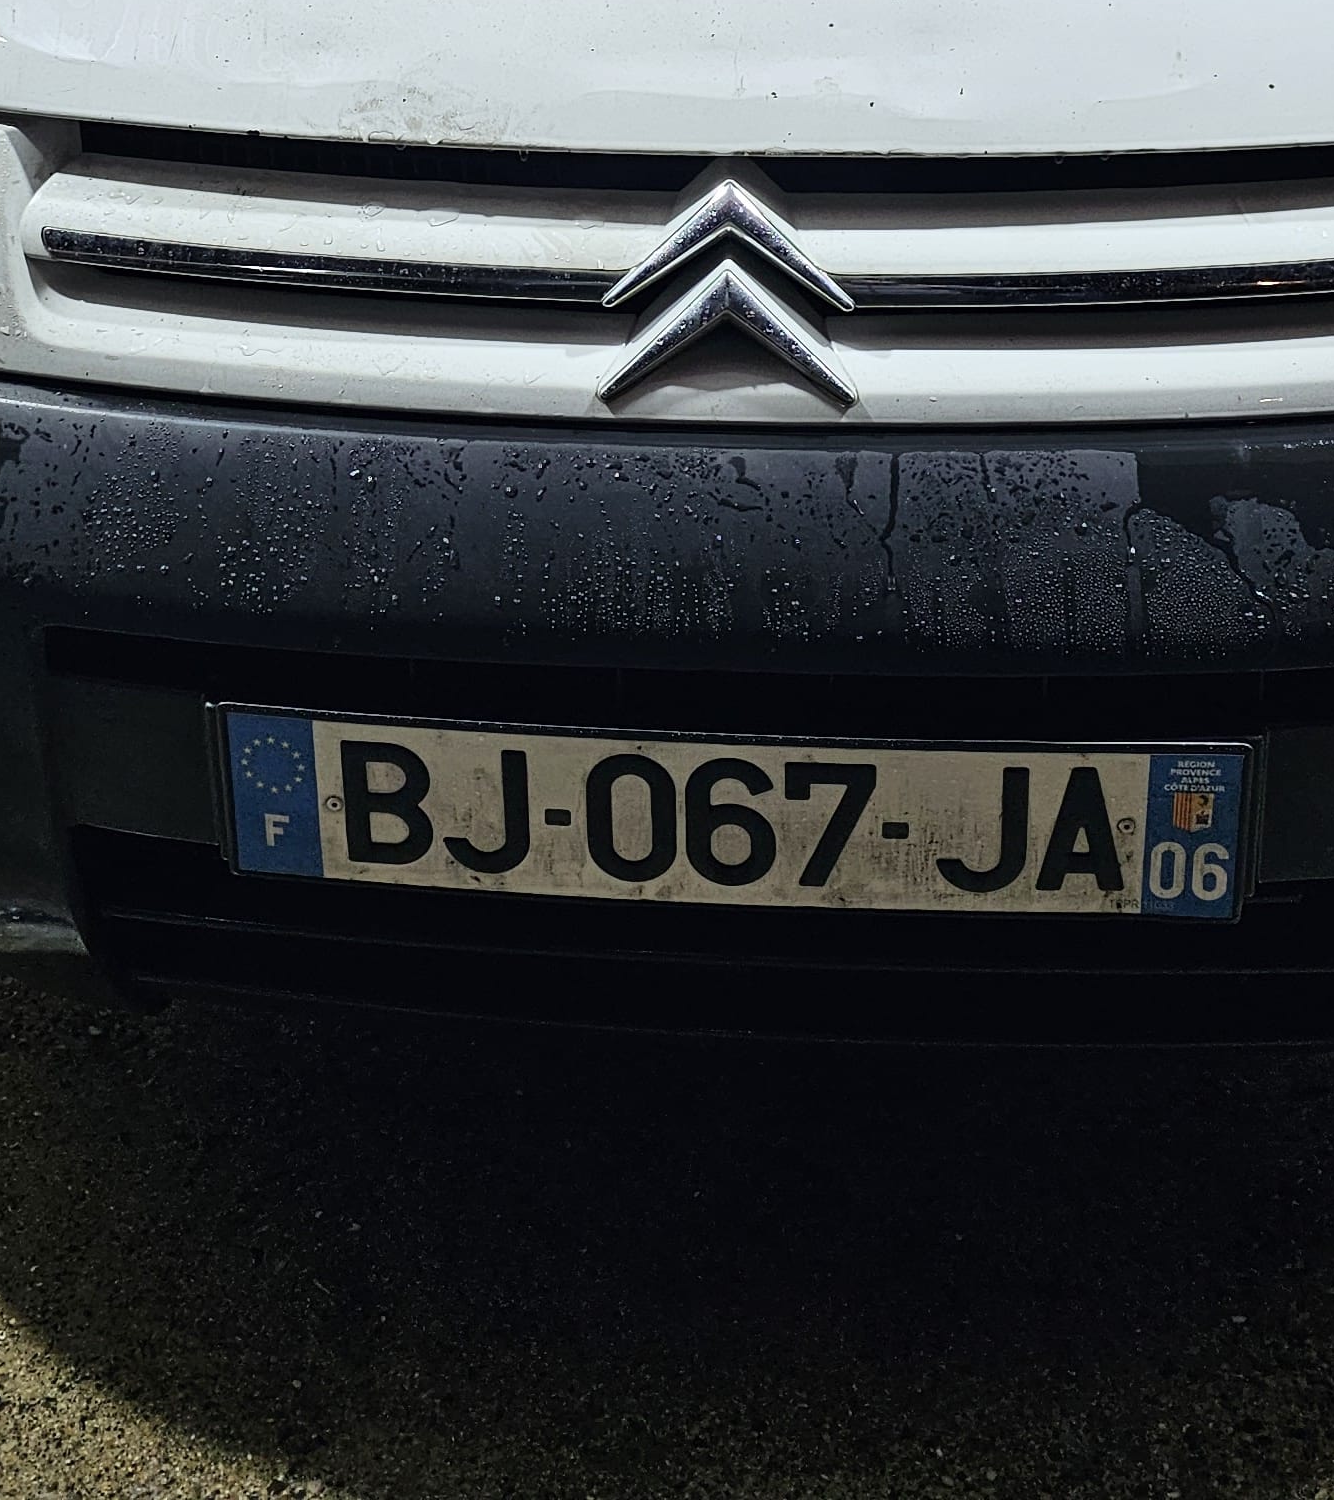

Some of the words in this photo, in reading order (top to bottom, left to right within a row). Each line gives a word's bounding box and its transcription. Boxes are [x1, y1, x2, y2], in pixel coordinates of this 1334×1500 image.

[1170, 768, 1222, 777] PROVENCE
[264, 813, 290, 847] F
[1149, 841, 1230, 901] 06
